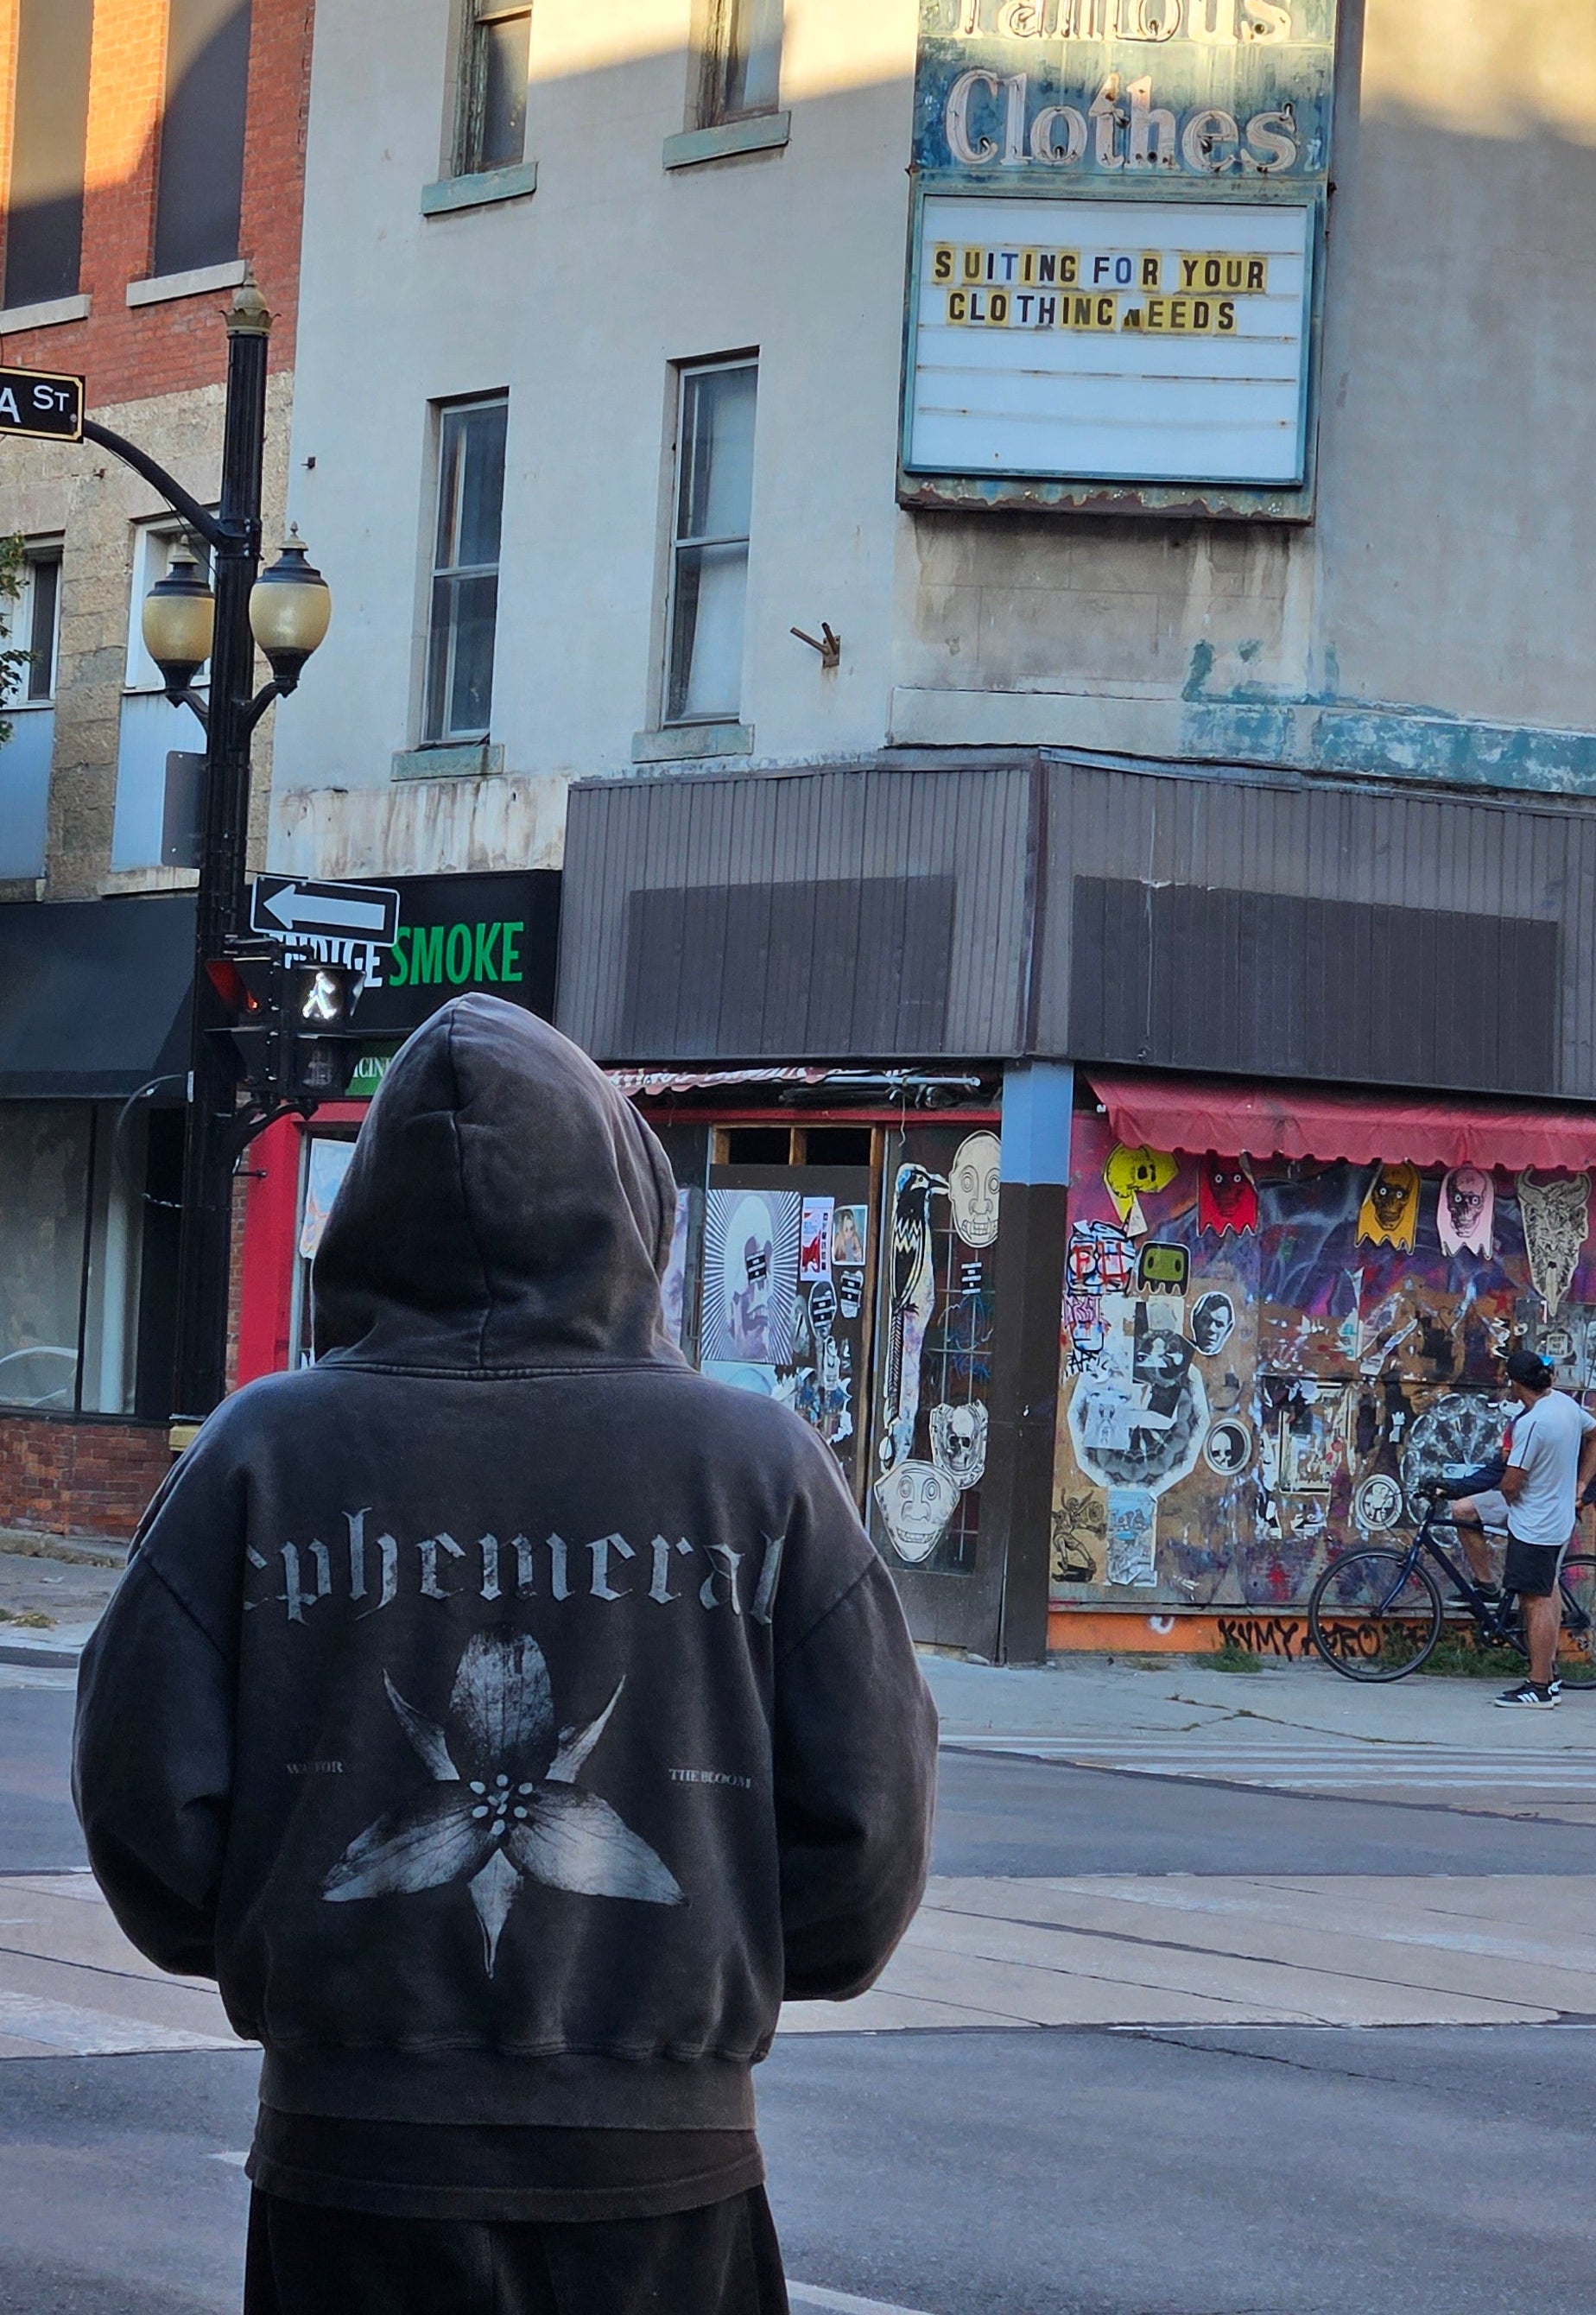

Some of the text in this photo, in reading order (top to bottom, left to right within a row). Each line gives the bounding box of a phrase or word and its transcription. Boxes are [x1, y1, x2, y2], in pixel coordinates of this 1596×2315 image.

[946, 69, 1296, 173] Clothes
[935, 251, 1264, 289] SUITING FOR YOUR
[33, 385, 70, 412] ST
[389, 922, 524, 986] SMOKE
